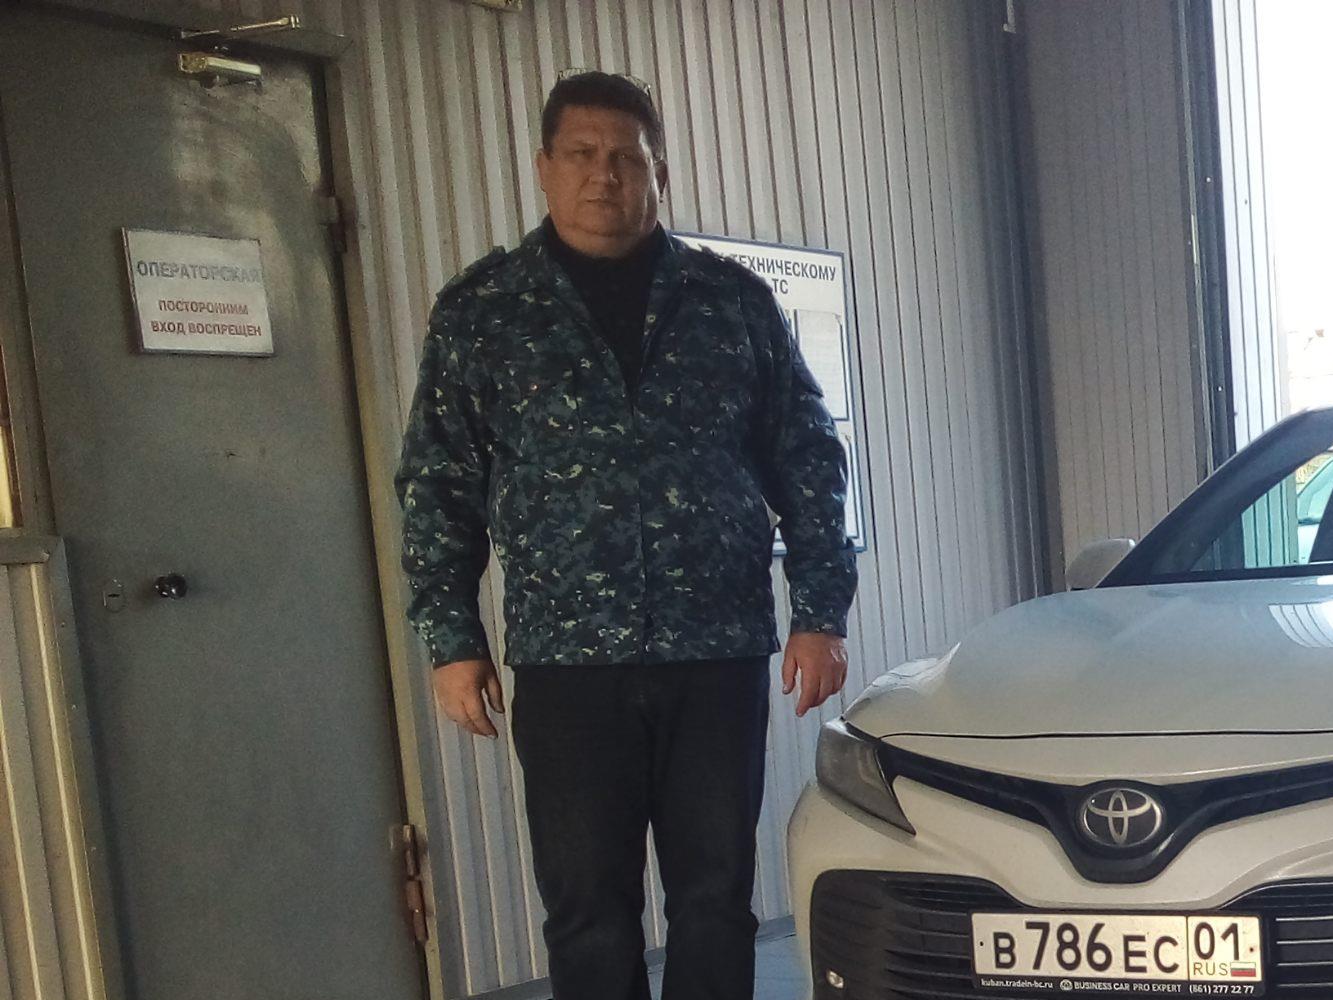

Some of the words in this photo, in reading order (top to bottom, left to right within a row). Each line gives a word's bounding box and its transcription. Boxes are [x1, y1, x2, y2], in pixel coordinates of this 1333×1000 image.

[136, 260, 262, 283] ОПЕРАТОРСКАЯ
[772, 278, 788, 294] ТС
[158, 300, 249, 315] ПОСТОРОННИМ
[151, 320, 186, 335] ВХОД
[188, 322, 262, 337] ВОСПРЕЩЕН
[1194, 921, 1240, 961] 01
[1193, 962, 1229, 976] RUS
[1074, 981, 1112, 991] BUSINESS
[1113, 982, 1130, 992] CAR
[1132, 983, 1150, 992] PRO
[1151, 983, 1182, 993] EXPERT
[1189, 984, 1211, 994] (861)
[1213, 985, 1229, 994] 277
[1230, 985, 1241, 994] 22
[1243, 985, 1255, 994] 77
